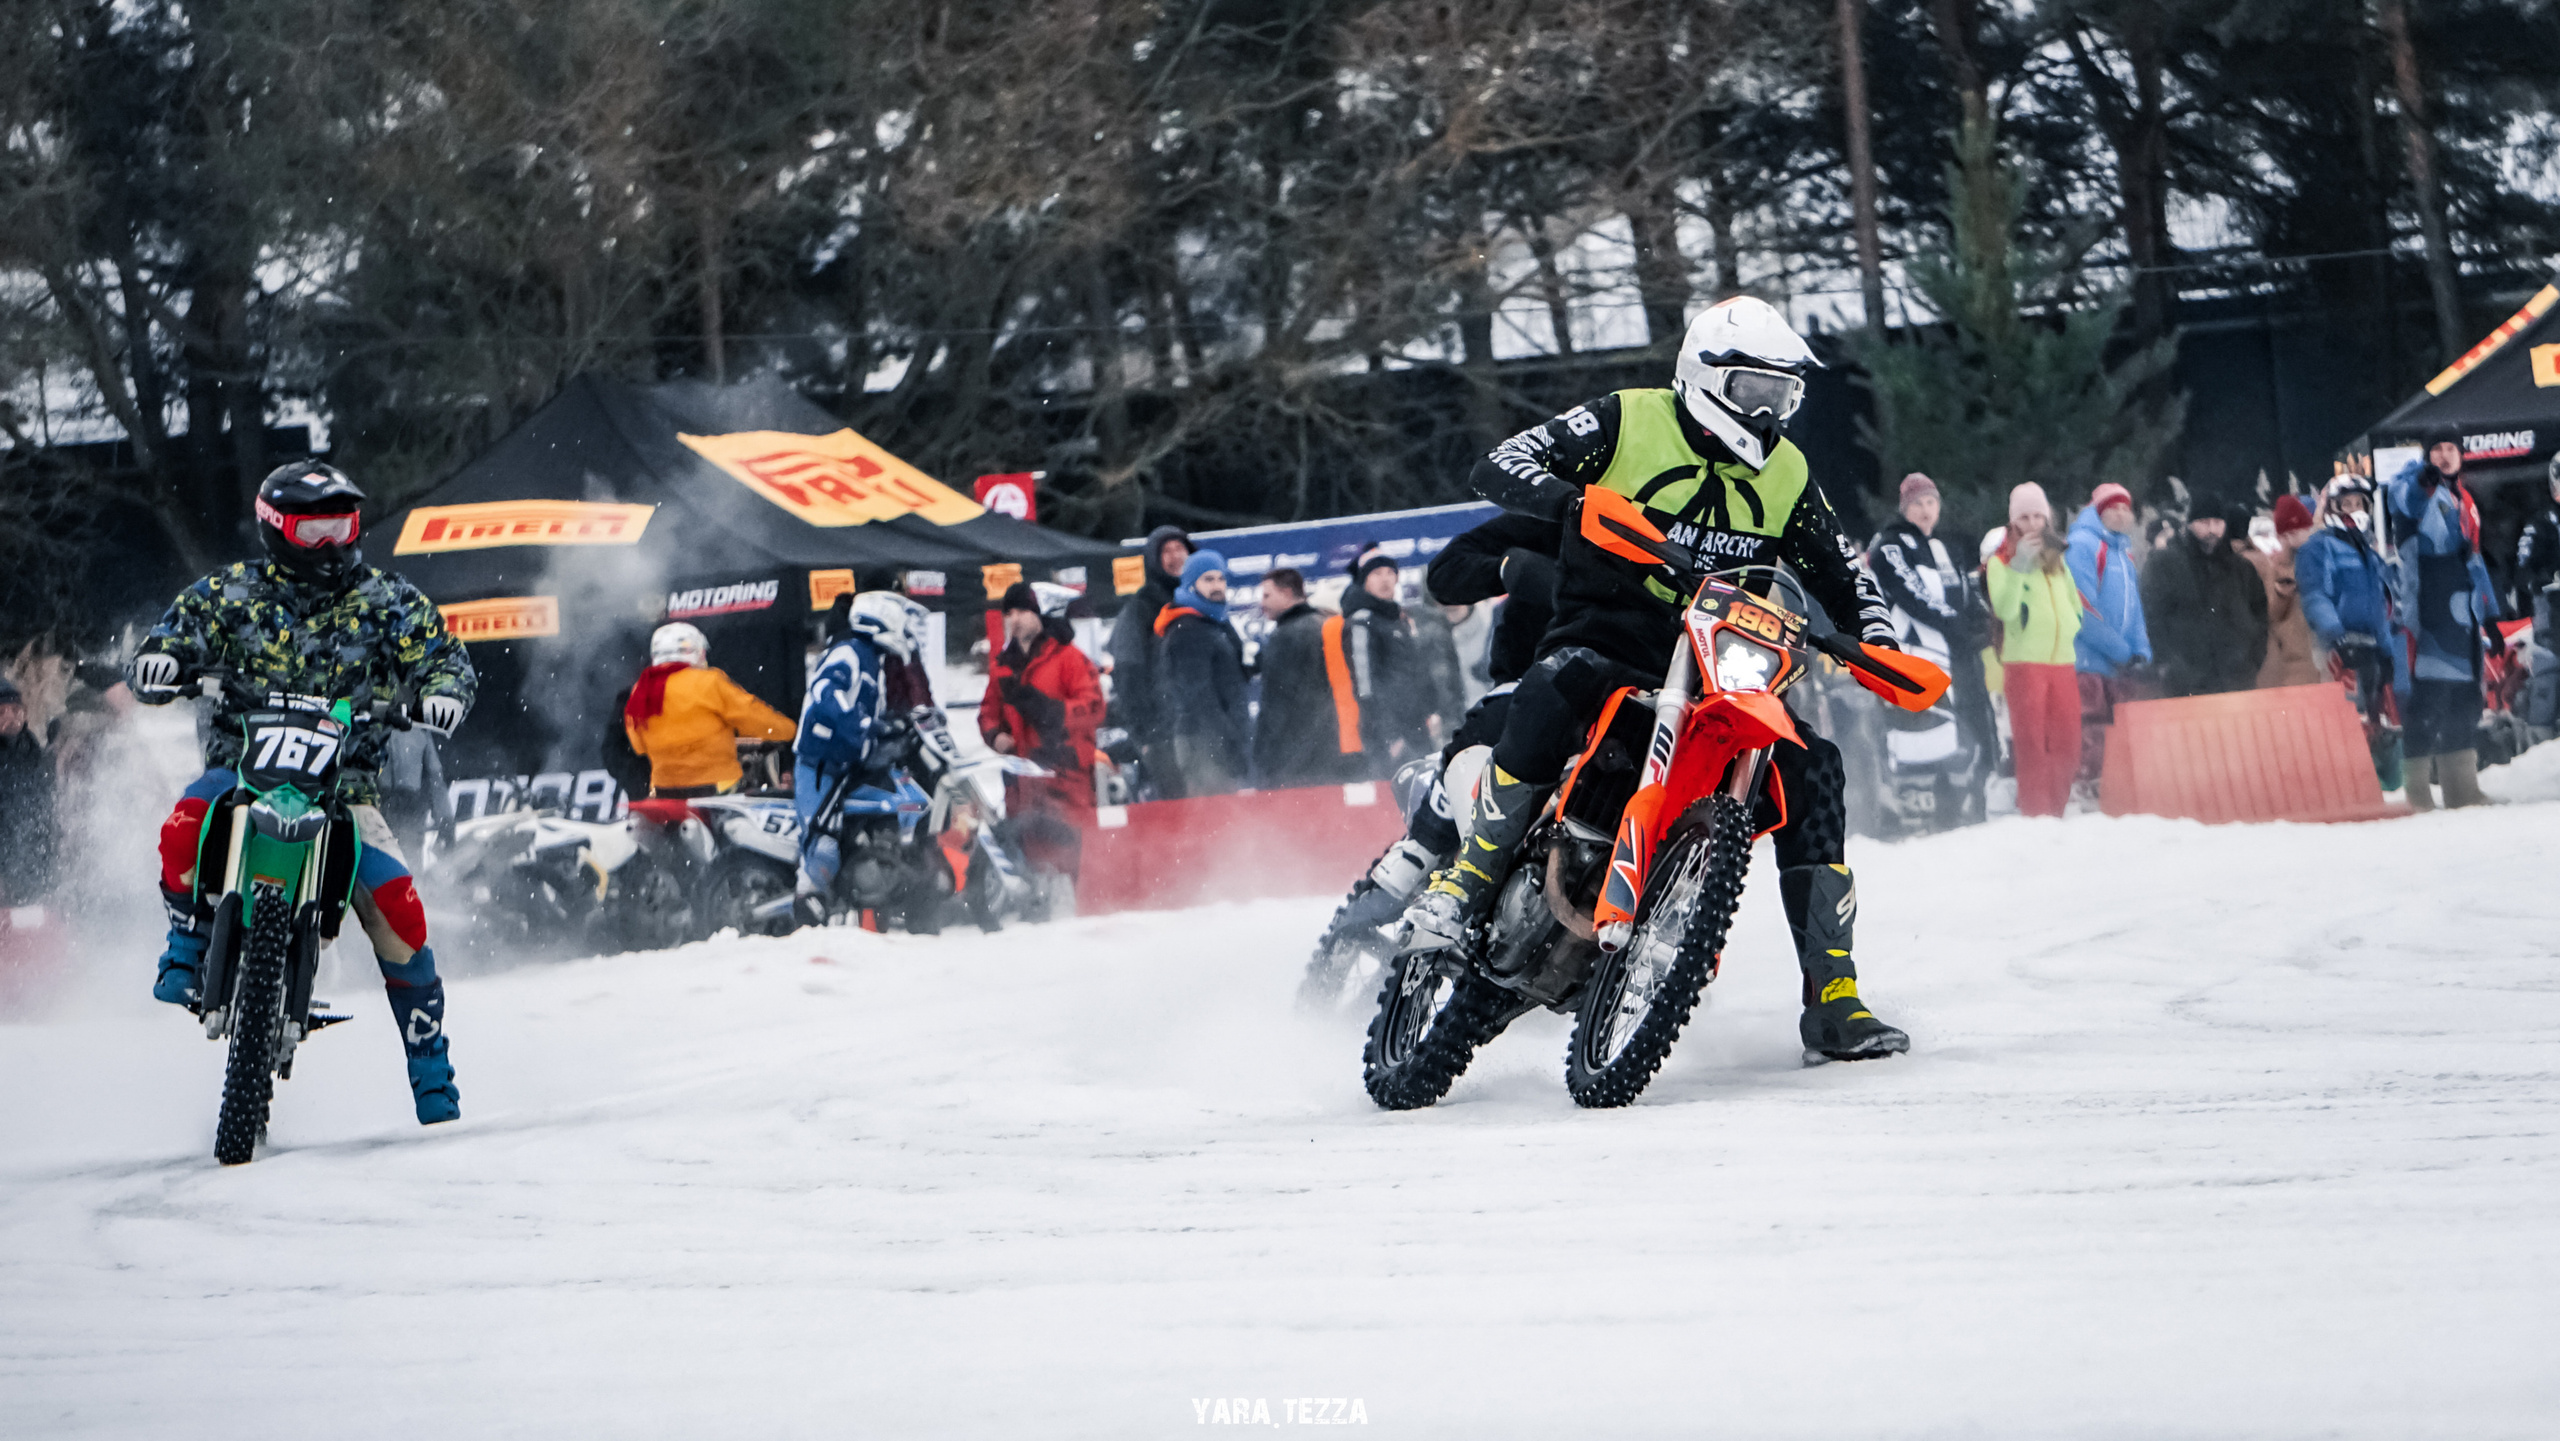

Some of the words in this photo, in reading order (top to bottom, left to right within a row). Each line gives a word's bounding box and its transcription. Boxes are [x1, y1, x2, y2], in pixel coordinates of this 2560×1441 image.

[668, 580, 779, 611] MOTORING
[1725, 601, 1782, 641] 198
[1695, 628, 1711, 659] MOTUL
[253, 726, 339, 777] 767
